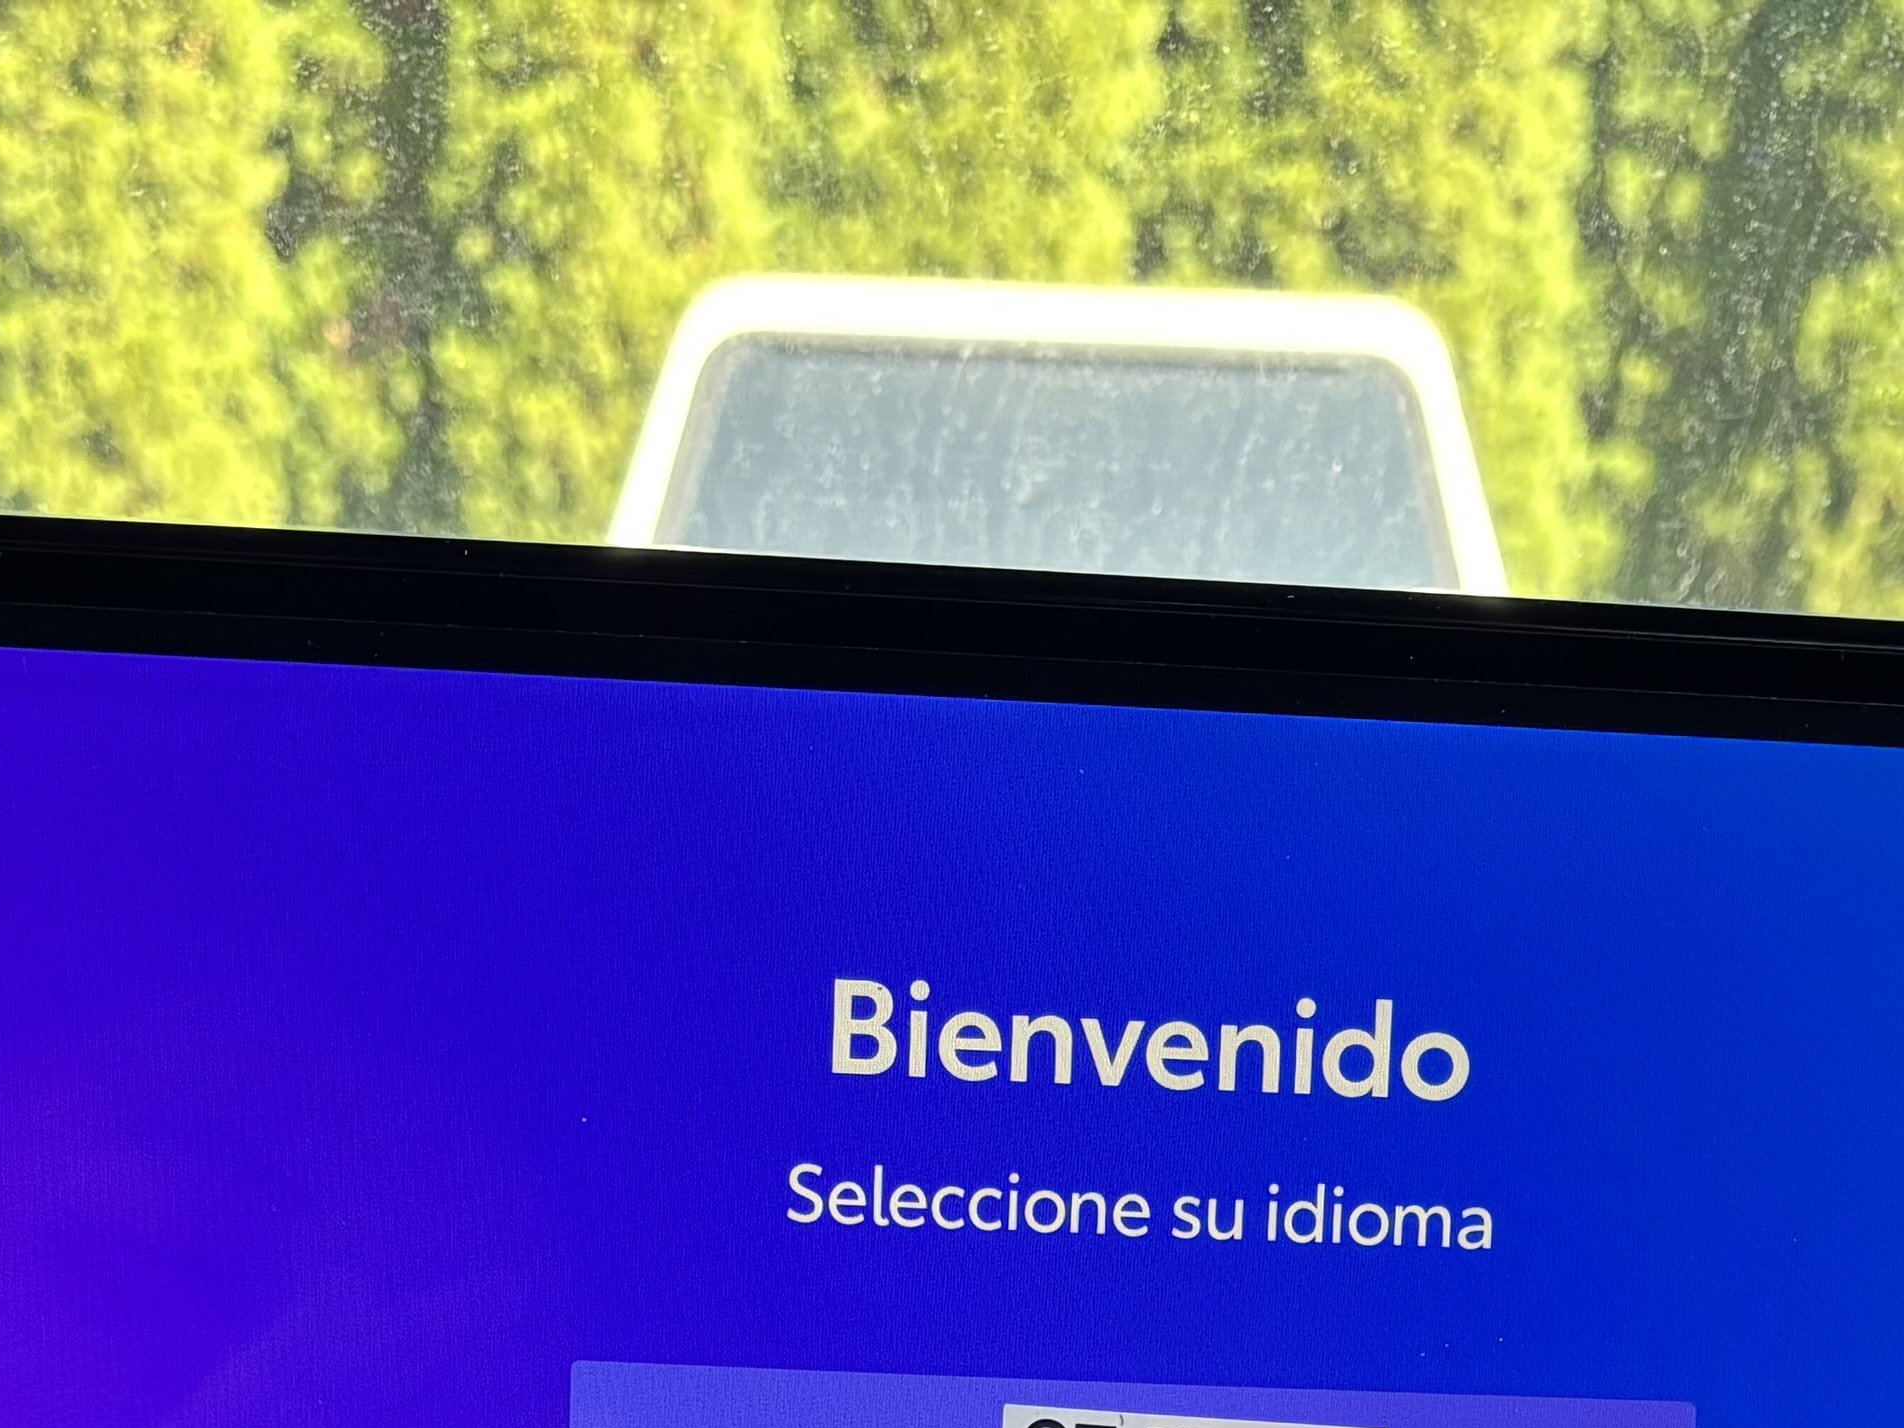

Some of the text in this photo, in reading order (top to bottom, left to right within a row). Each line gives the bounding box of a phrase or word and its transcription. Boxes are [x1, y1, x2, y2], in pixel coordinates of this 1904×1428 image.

[832, 979, 1469, 1101] Bienvenido
[787, 1163, 1492, 1249] Seleccione su idioma
